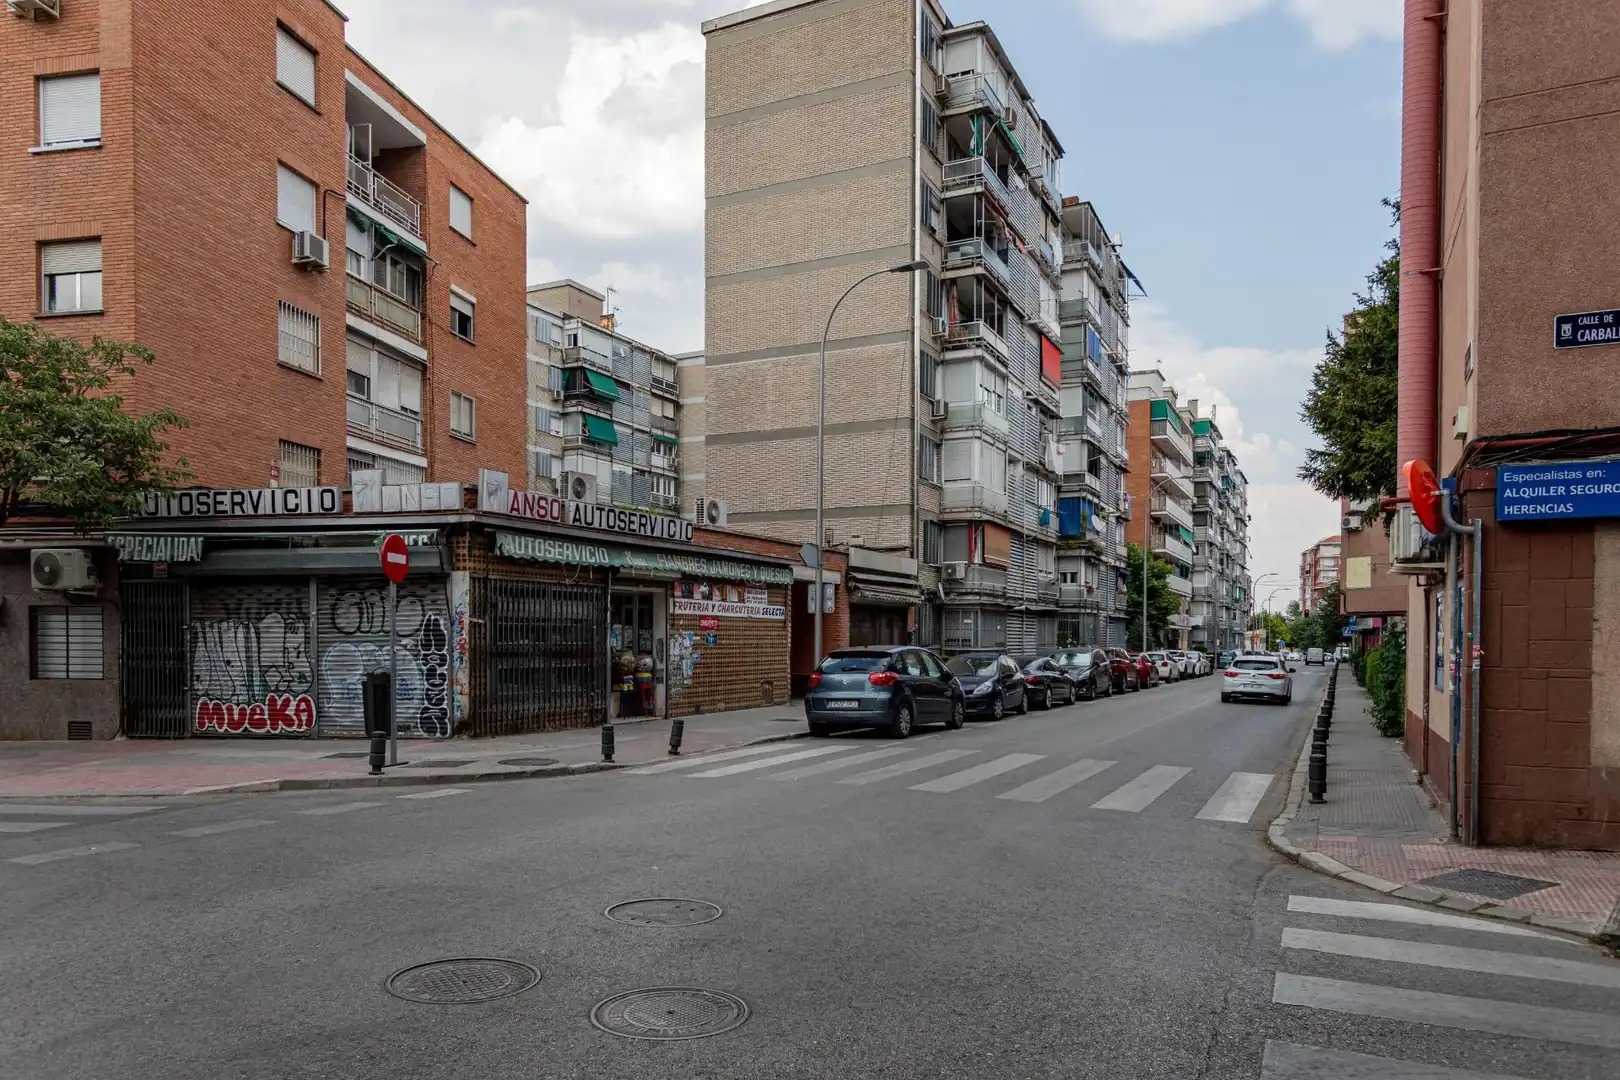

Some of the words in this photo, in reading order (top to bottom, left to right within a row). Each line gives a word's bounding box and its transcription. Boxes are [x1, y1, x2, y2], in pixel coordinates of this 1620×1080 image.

[1578, 315, 1600, 325] CALLE
[1603, 314, 1614, 323] DE
[1503, 470, 1583, 483] Especialistas
[1586, 469, 1606, 479] en:
[1503, 486, 1566, 499] ALQUILER
[137, 488, 337, 517] UTOSERVICIO
[1504, 503, 1574, 515] HERENCIAS
[571, 504, 694, 541] AUTOSERVICIO
[504, 535, 609, 564] AUTOSERVICIO
[710, 559, 750, 578] JAMONES
[753, 564, 759, 579] Y
[760, 566, 790, 583] QUESOS
[675, 600, 709, 613] FRUTERIA
[711, 603, 716, 613] Y
[717, 603, 760, 616] CHARCUTERIA
[761, 607, 785, 617] SELECTA
